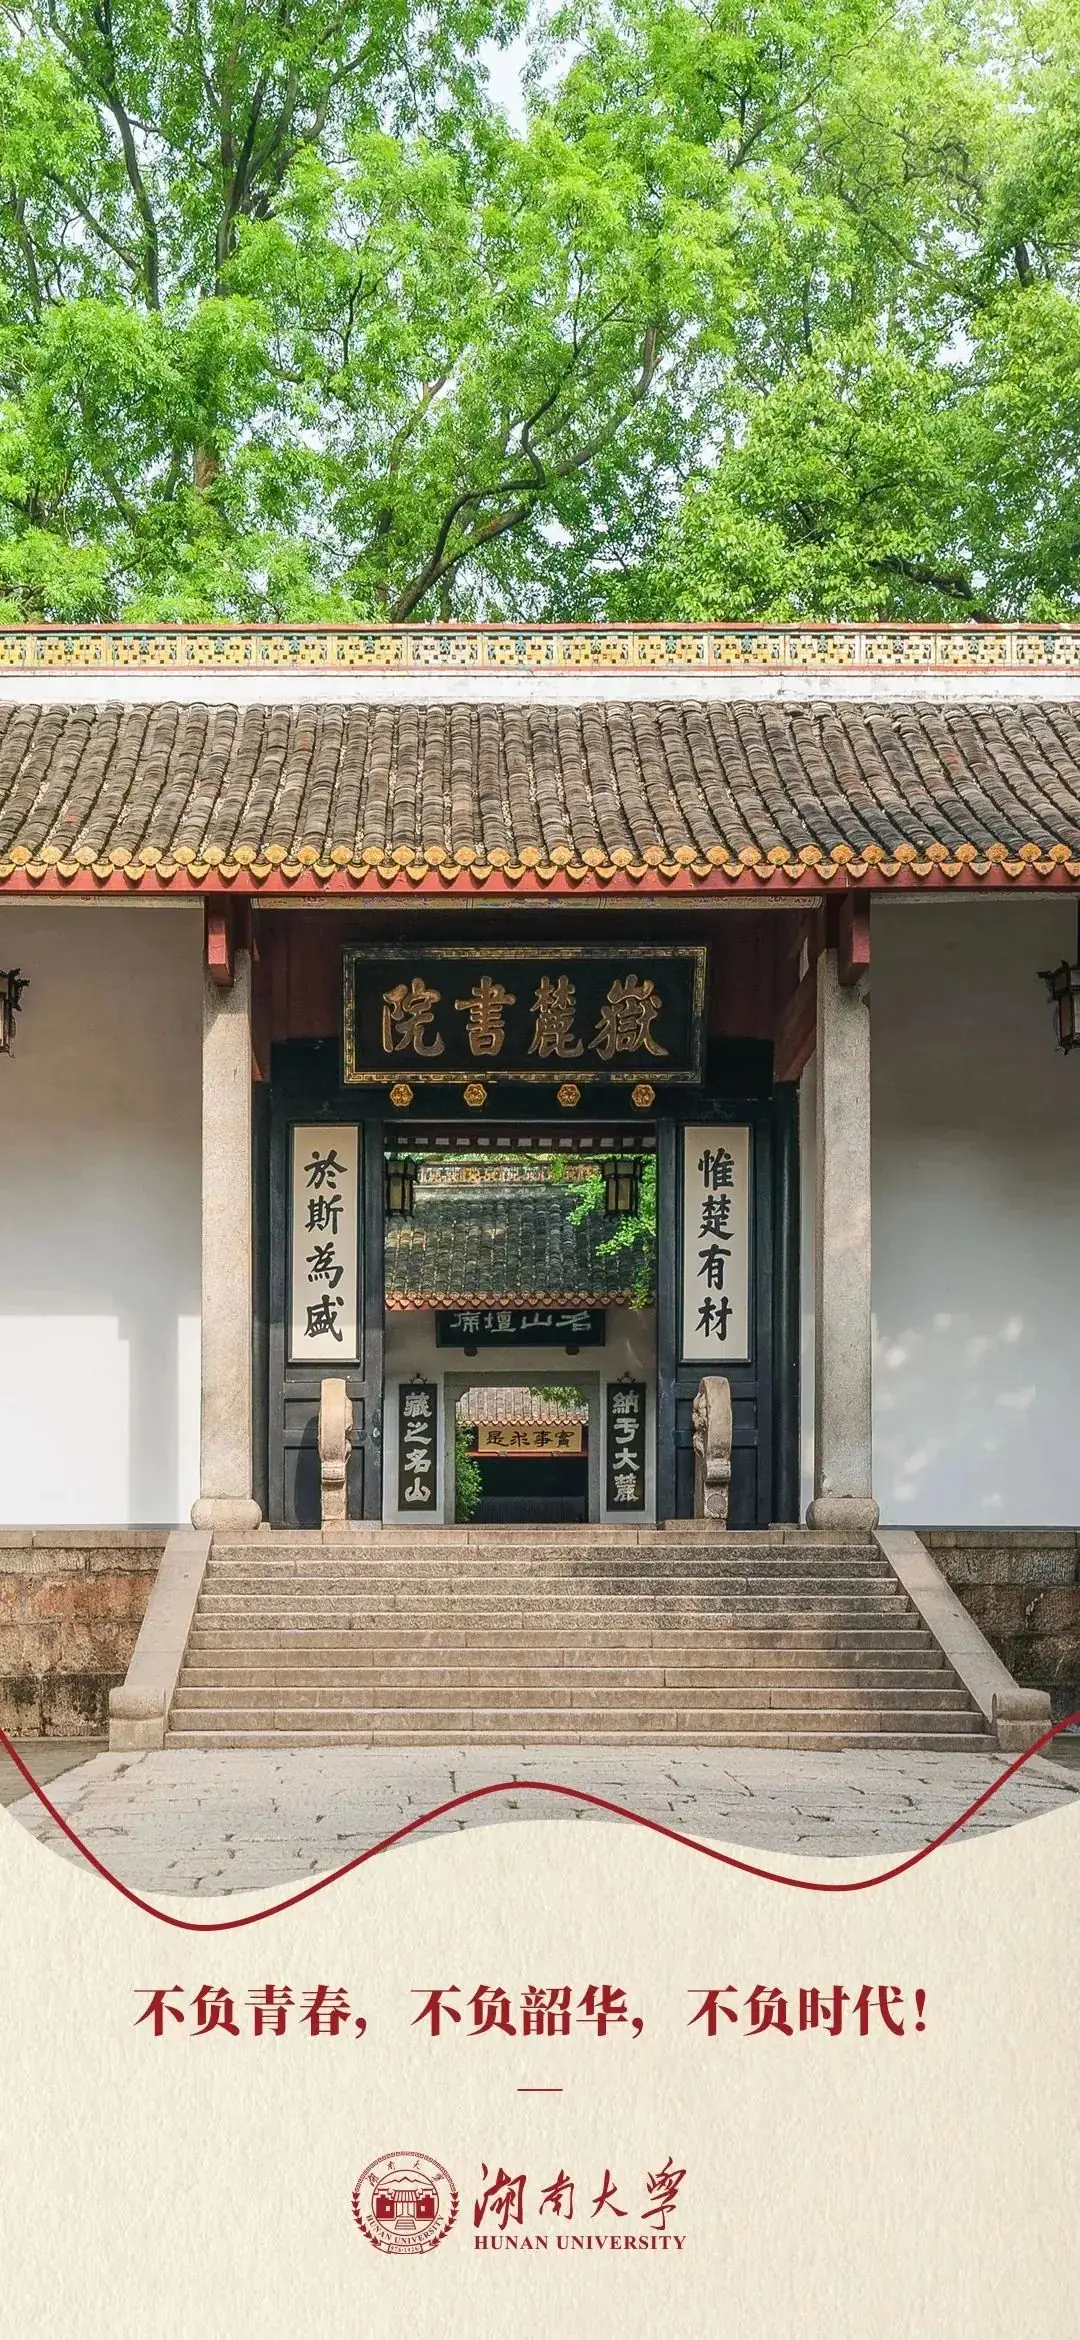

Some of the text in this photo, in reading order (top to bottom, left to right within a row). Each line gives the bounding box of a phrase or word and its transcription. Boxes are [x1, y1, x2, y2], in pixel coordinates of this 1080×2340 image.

[382, 974, 669, 1060] 嶽麓書院
[695, 1147, 736, 1342] 惟楚有材
[403, 1391, 433, 1502] 藏之名山
